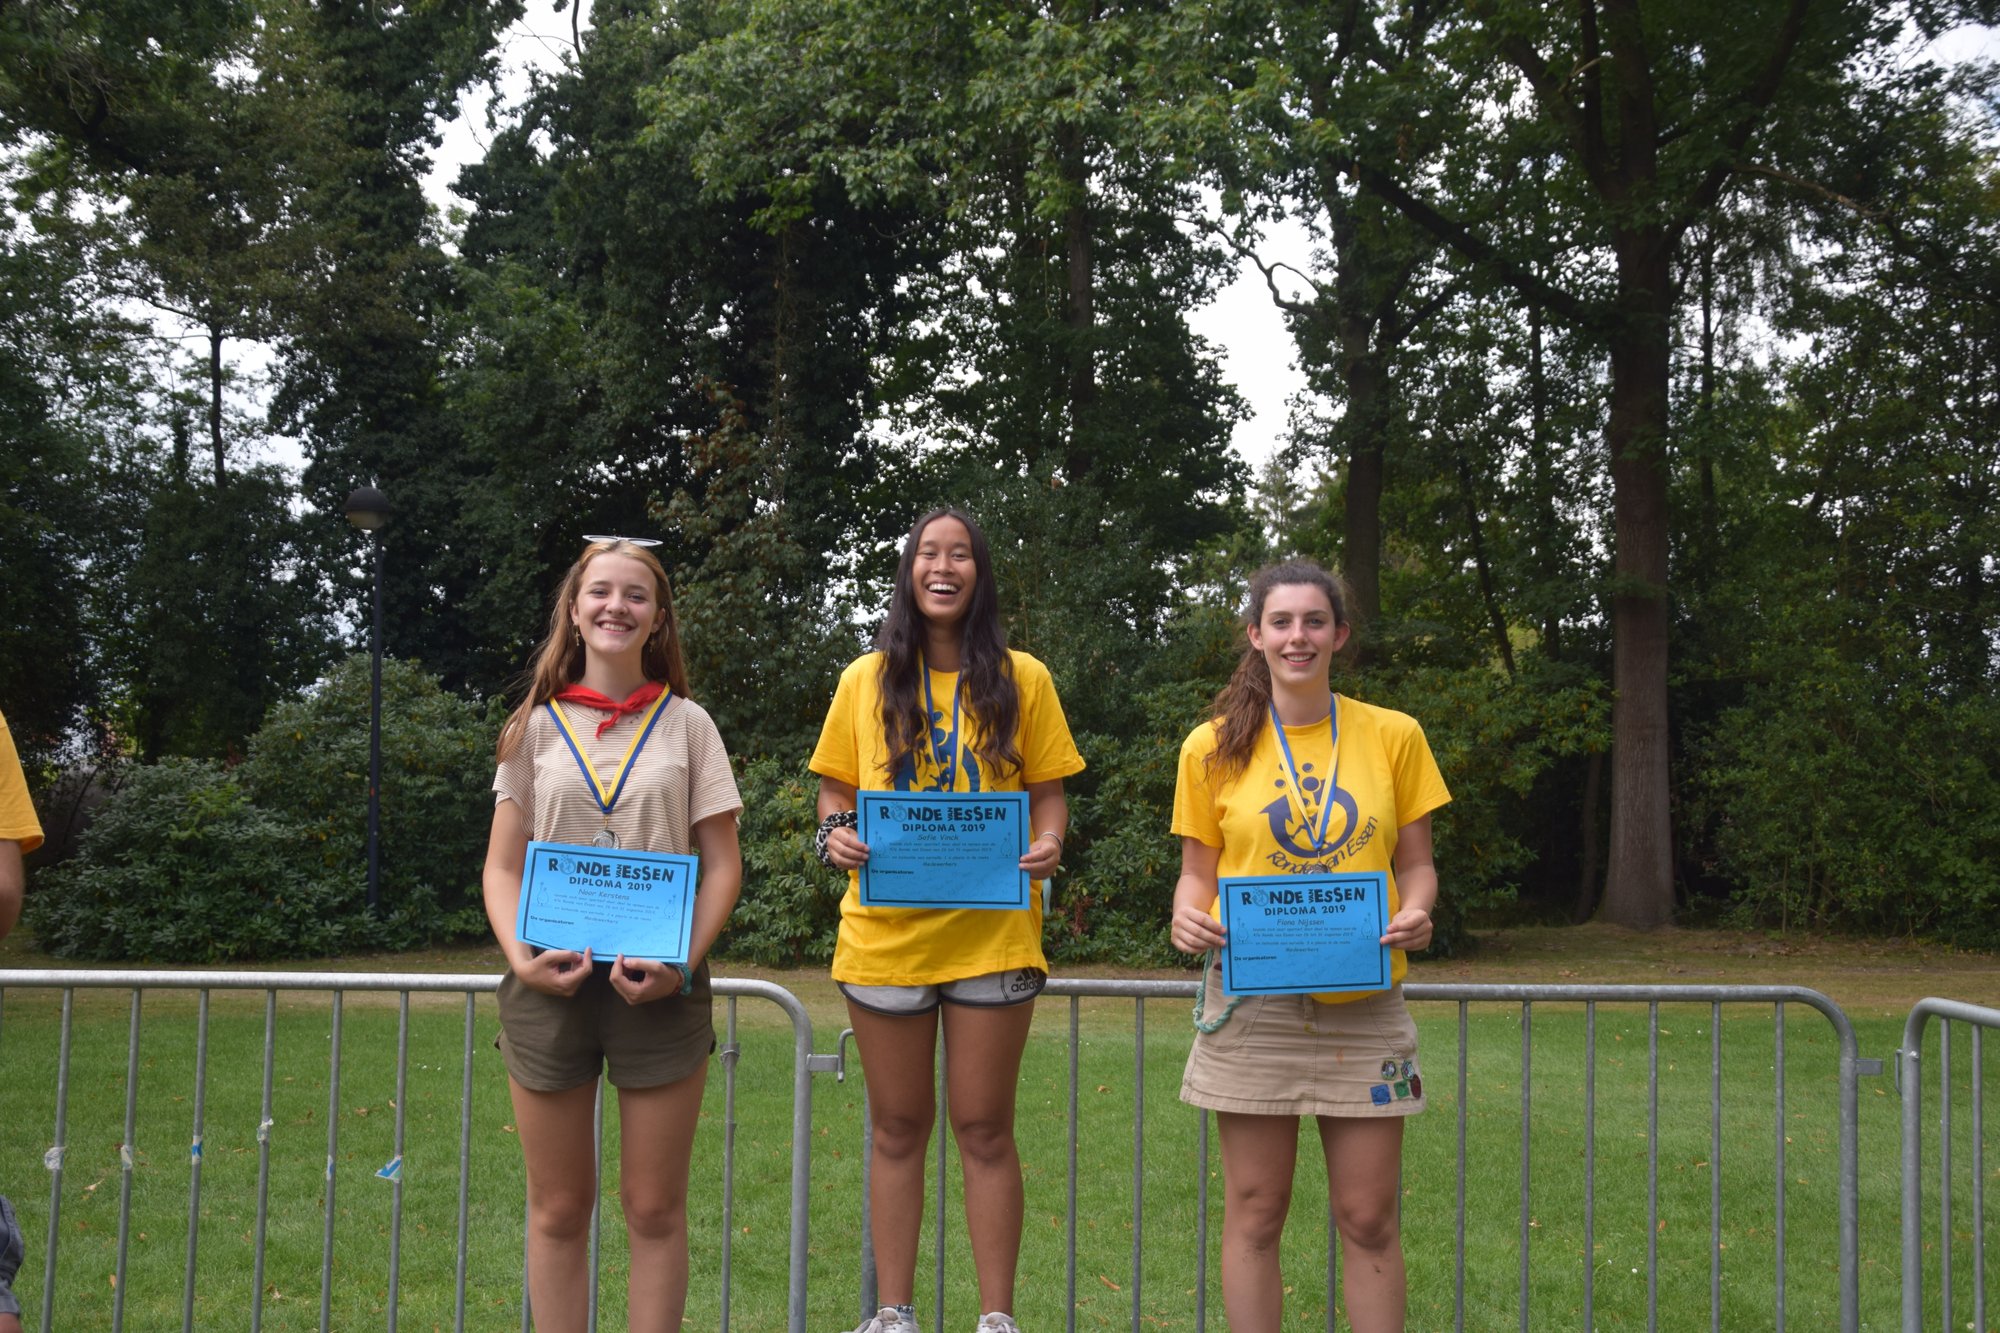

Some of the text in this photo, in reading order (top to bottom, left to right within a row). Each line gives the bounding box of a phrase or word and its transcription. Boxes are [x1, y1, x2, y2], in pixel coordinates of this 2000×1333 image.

[954, 805, 1007, 821] ESSEN
[902, 824, 986, 832] DIPLOMA 2019
[1326, 850, 1346, 870] an
[1347, 816, 1378, 857] Essen
[622, 865, 675, 883] ESSEN
[569, 876, 653, 891] DIPLOMA 2019
[578, 888, 597, 896] Noor
[1314, 887, 1366, 903] ESSEN
[1264, 905, 1346, 916] DIPLOMA 2019
[1298, 919, 1325, 927] Nijssen
